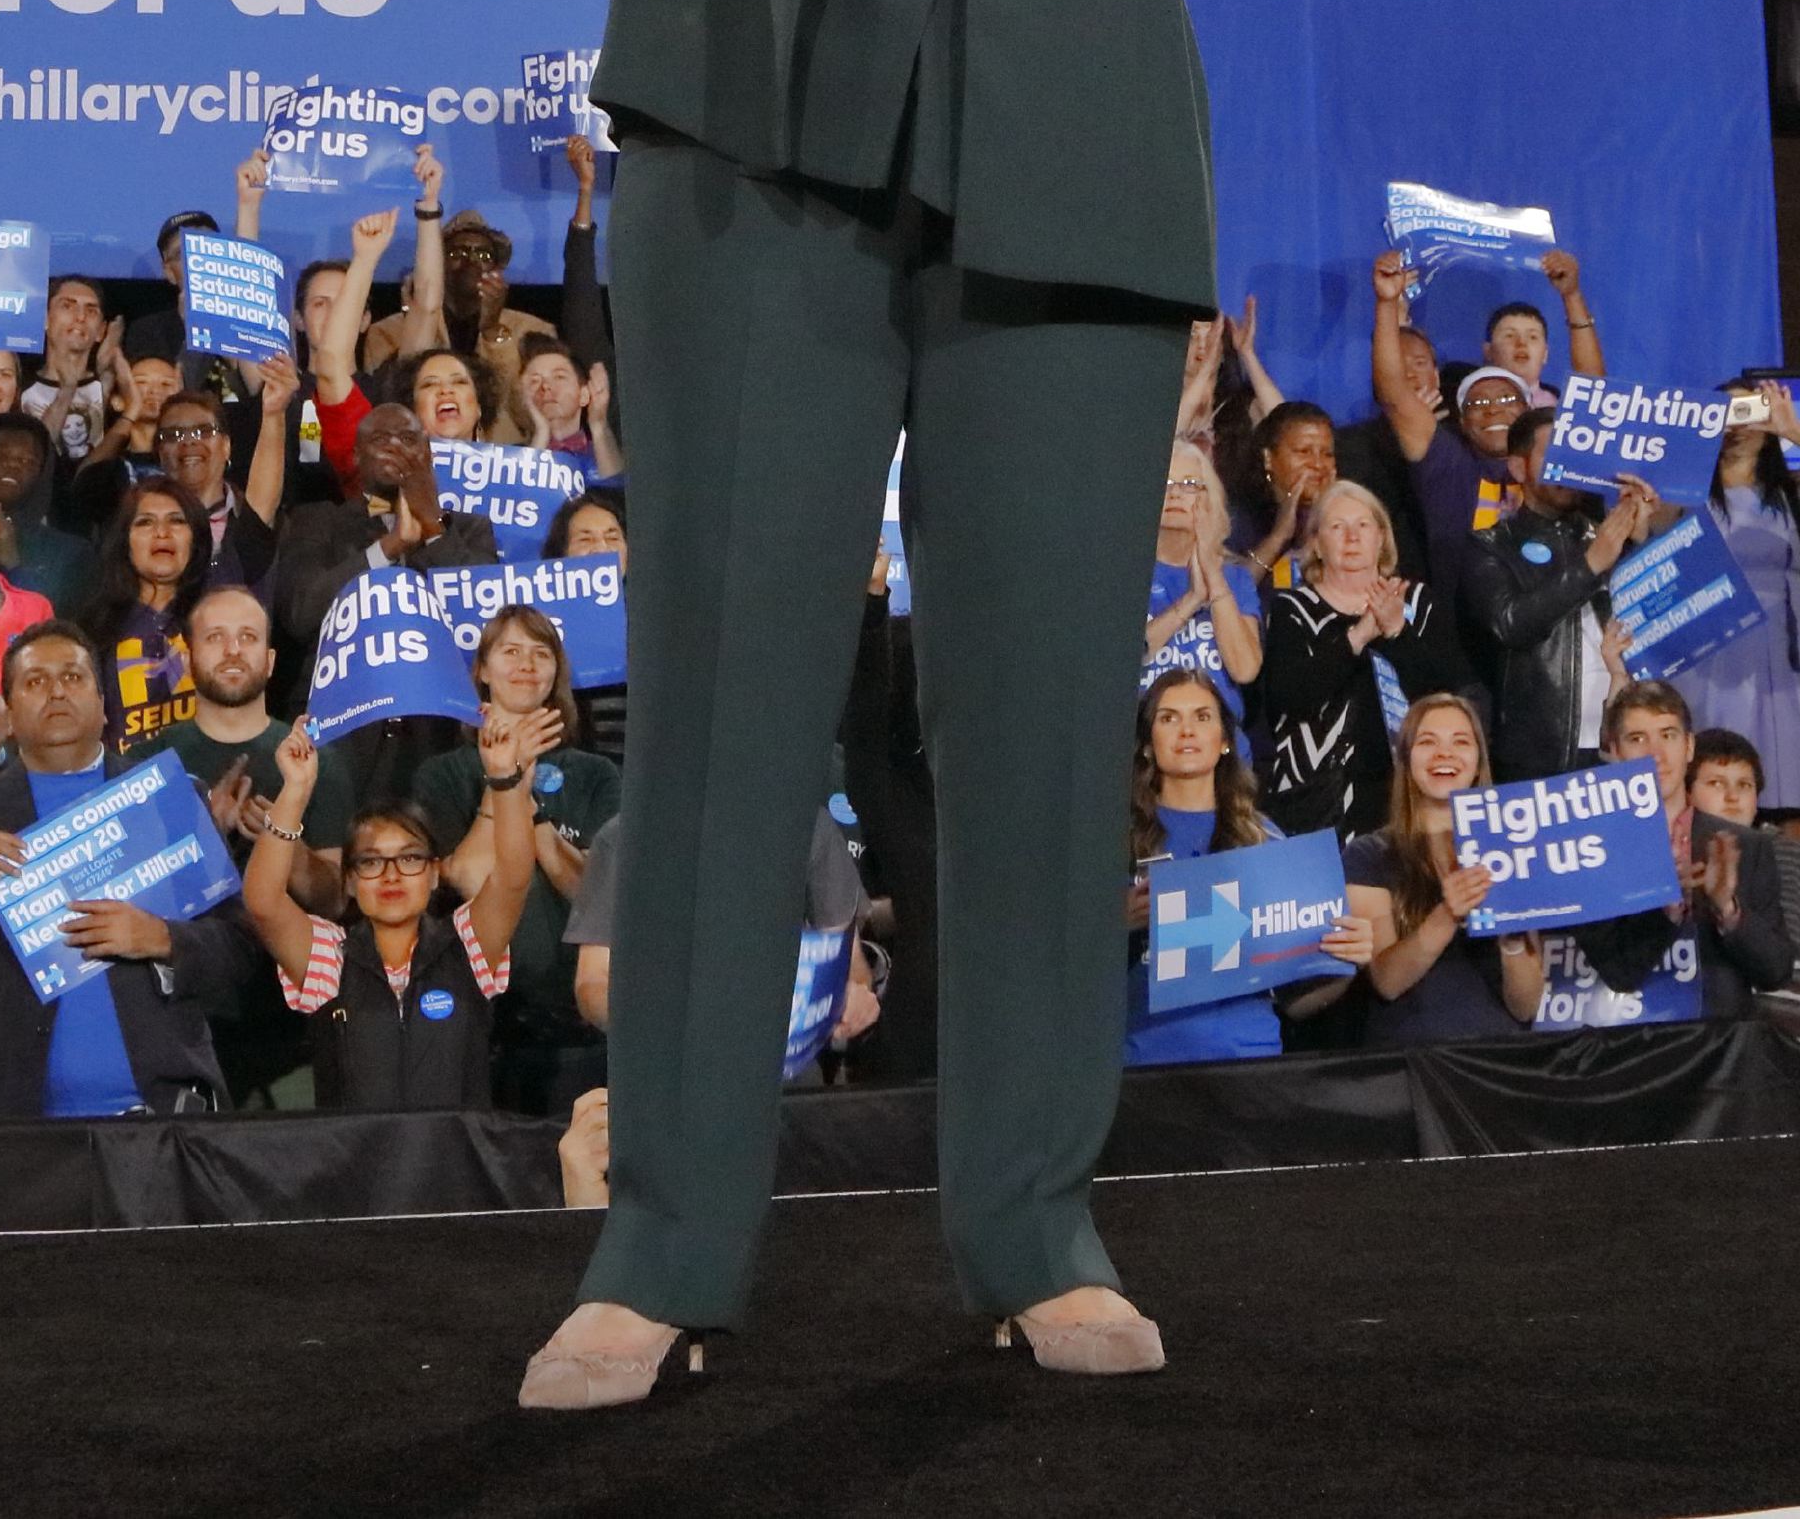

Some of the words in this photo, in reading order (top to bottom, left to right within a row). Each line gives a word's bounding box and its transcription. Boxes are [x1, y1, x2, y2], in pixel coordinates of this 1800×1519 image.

[272, 86, 424, 135] Fighting
[527, 90, 563, 124] for
[265, 128, 314, 152] for
[321, 130, 368, 158] us
[185, 234, 224, 255] The
[228, 242, 284, 280] Nevada
[188, 254, 259, 283] Caucus
[263, 269, 274, 289] is
[190, 273, 276, 311] Saturday,
[191, 294, 274, 330] February
[1562, 376, 1727, 438] Fighting
[1553, 412, 1616, 455] for
[1620, 434, 1667, 462] us
[438, 492, 482, 514] or
[490, 496, 539, 528] us
[432, 562, 619, 618] Fighting
[1658, 562, 1679, 581] 20
[1669, 605, 1688, 628] for
[1688, 579, 1733, 616] Hillary
[365, 630, 428, 667] us
[125, 696, 196, 736] SEIU
[320, 696, 393, 730] hillaryclinton.com
[72, 764, 163, 831] conmigo!
[1453, 772, 1659, 843] Fighting
[93, 822, 122, 849] 20
[103, 877, 134, 899] for
[135, 841, 200, 888] Hillary
[1457, 839, 1537, 883] for
[1546, 834, 1607, 874] us
[8, 887, 65, 926] 11am
[1252, 898, 1343, 938] Hillary
